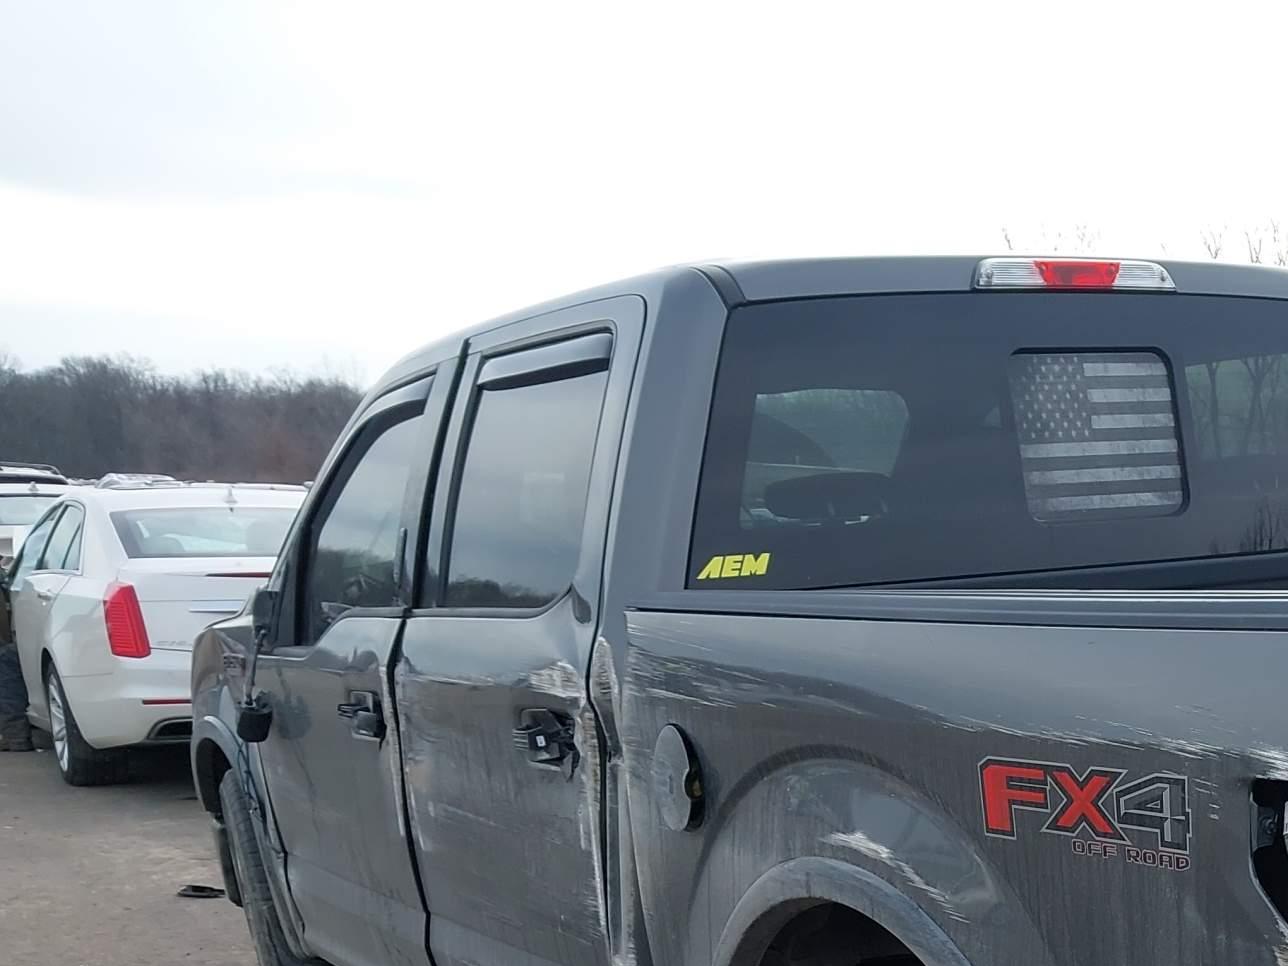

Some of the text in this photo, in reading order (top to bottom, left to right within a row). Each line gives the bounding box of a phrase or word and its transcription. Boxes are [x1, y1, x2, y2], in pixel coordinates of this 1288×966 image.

[696, 552, 771, 580] AEM
[977, 756, 1193, 855] FX4
[1071, 838, 1191, 872] OFF ROAD
